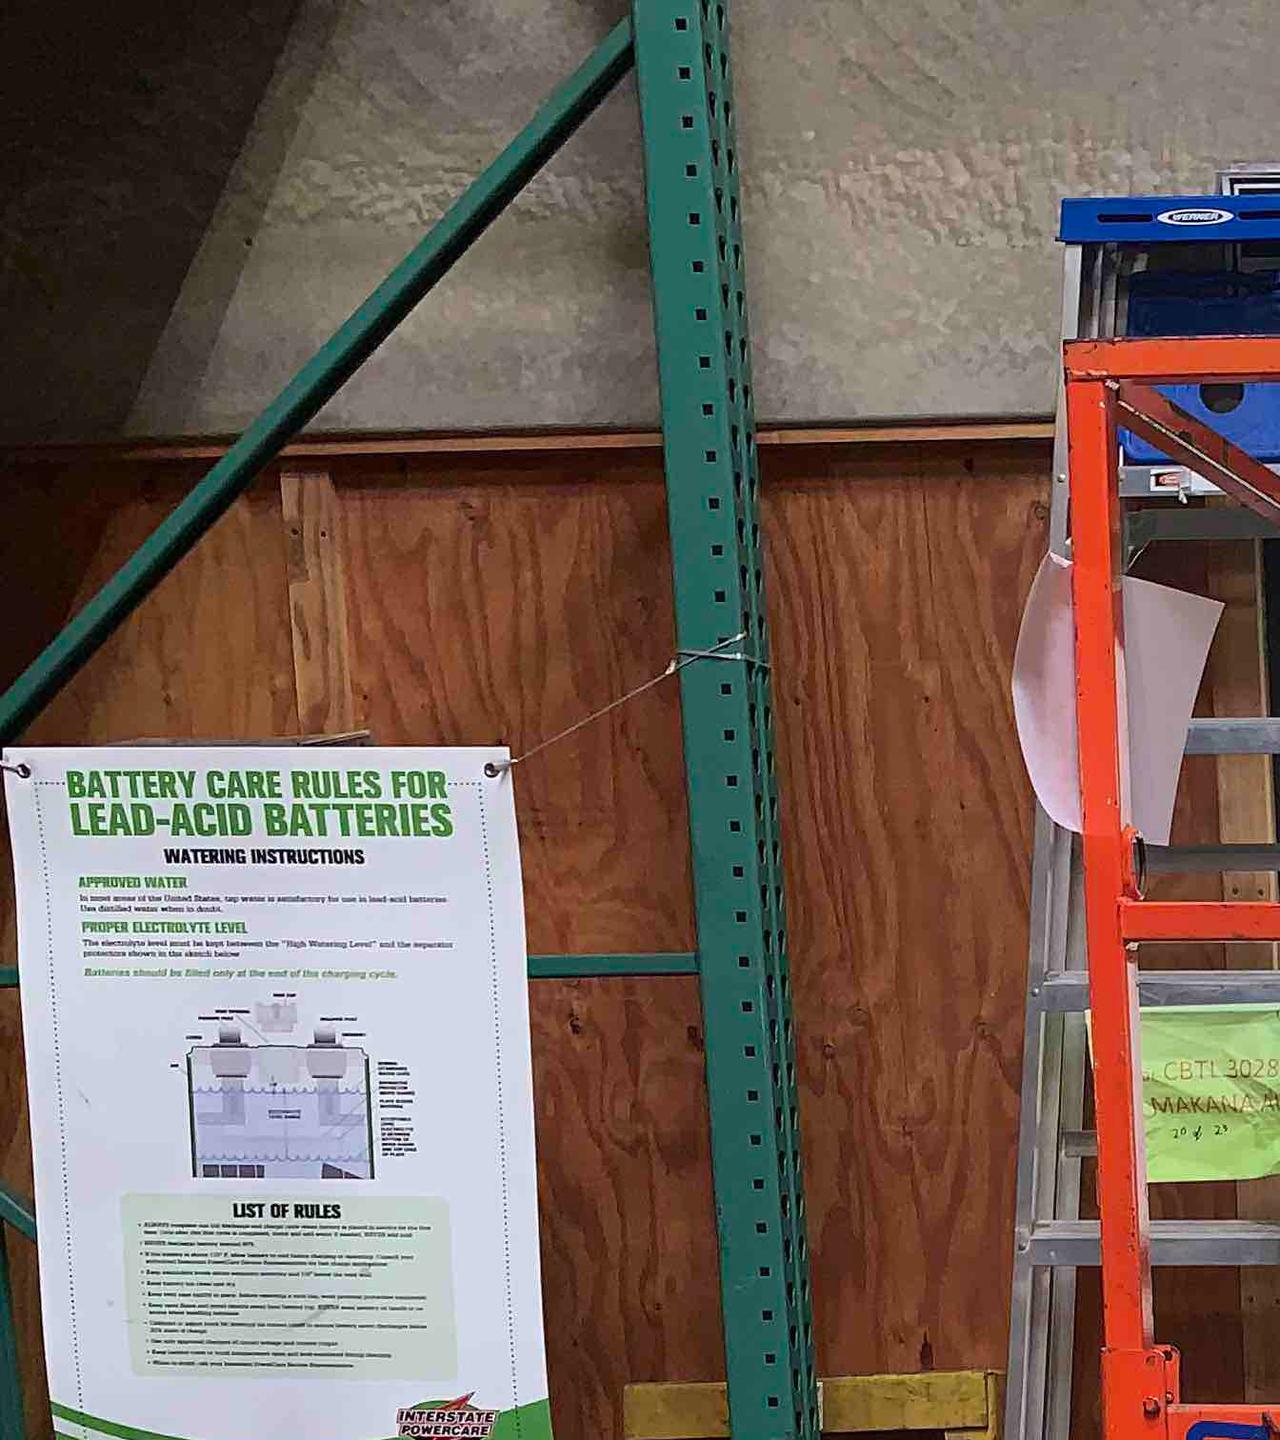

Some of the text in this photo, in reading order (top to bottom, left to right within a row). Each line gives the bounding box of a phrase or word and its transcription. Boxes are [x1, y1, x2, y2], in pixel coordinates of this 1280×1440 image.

[66, 770, 448, 799] BATTERY CARE RULES FOR
[70, 803, 454, 836] LEAD-ACID BATTERIES
[164, 849, 365, 864] WATERING INSTRUCTIONS
[78, 876, 188, 888] APPROVED WATER
[82, 922, 247, 934] PROPER ELECTROLYTE LEVEL
[1226, 1058, 1280, 1080] 3028
[1150, 1096, 1257, 1115] MAKANA
[233, 1203, 341, 1219] LIST OF RULES
[399, 1411, 495, 1423] INTERSTATE
[401, 1425, 490, 1436] POWERCARE
